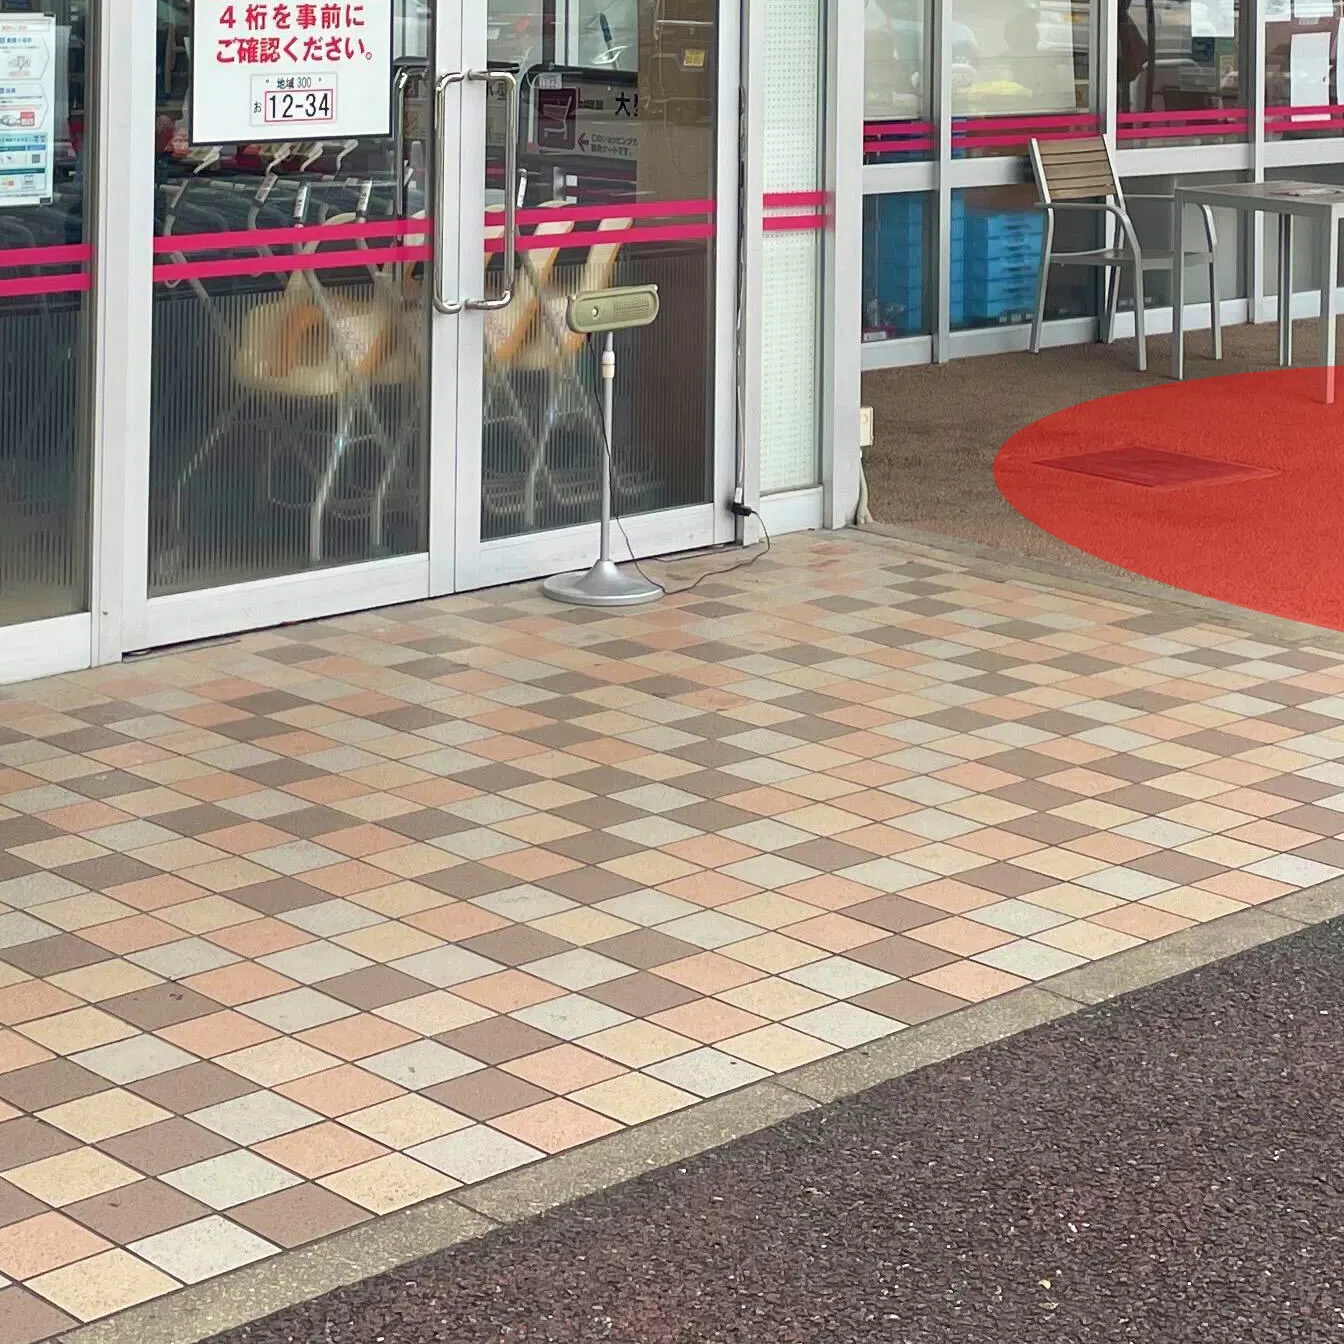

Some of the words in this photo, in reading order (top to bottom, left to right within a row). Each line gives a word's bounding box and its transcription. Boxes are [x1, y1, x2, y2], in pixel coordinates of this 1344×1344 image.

[216, 37, 373, 64] ご確認ください。
[269, 92, 329, 118] 12-34
[614, 91, 638, 117] 大
